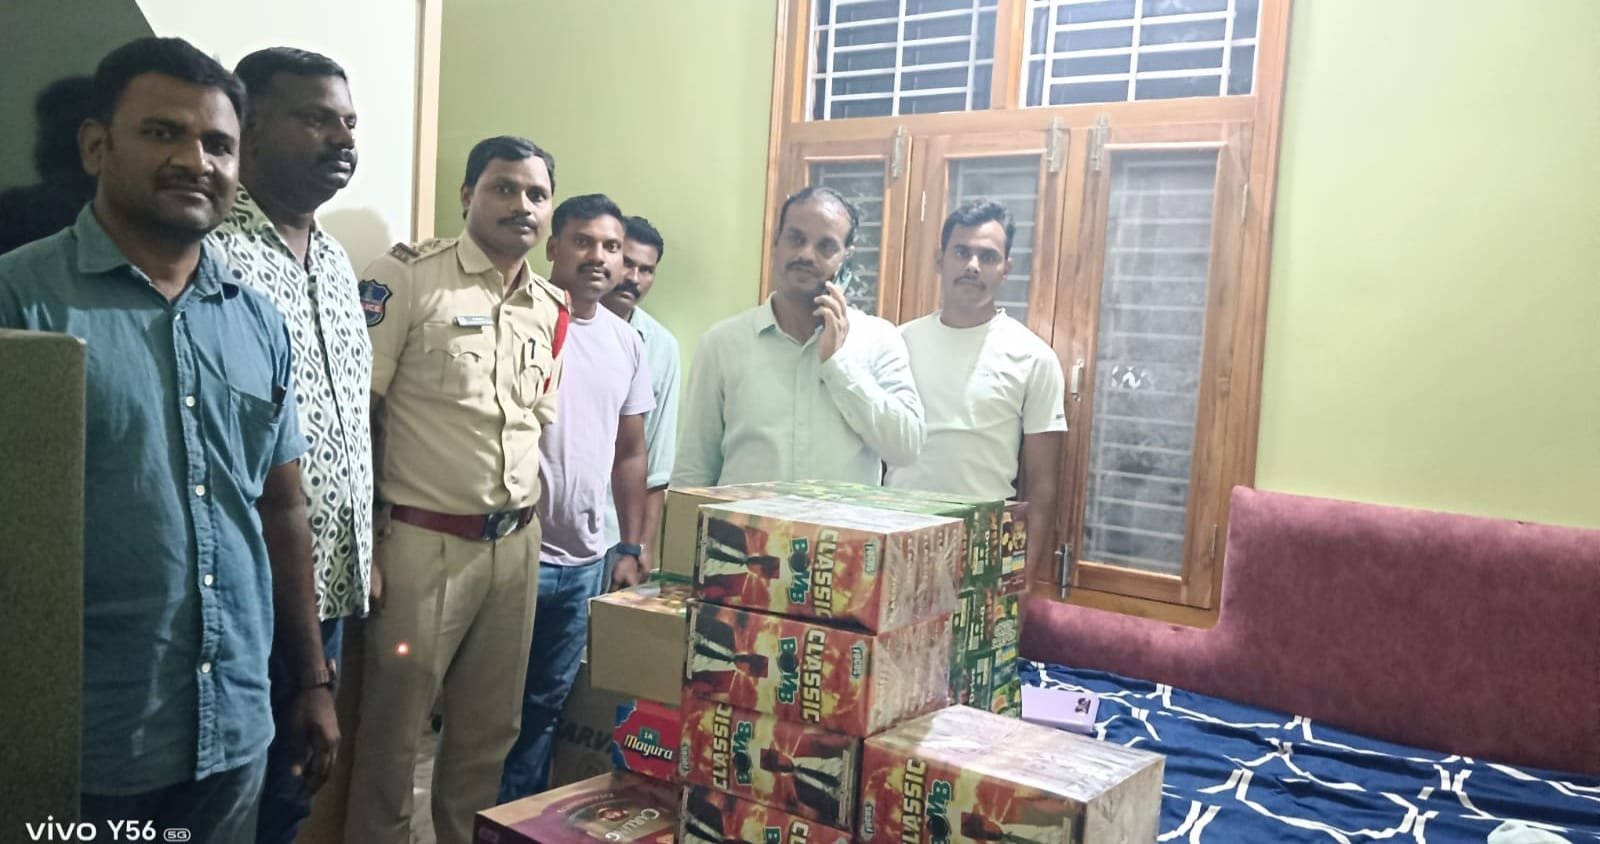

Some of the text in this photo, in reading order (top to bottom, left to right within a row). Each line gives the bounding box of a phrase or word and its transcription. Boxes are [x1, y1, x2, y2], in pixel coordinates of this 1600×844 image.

[791, 537, 811, 604] BOMB
[813, 528, 839, 619] CLASSIC
[778, 636, 799, 704] BOMB
[802, 629, 826, 722] CLASSIC
[624, 734, 673, 760] Mayura
[712, 703, 733, 790] CLASSIC
[731, 720, 753, 785] BOMB
[902, 759, 927, 844] LASSIC
